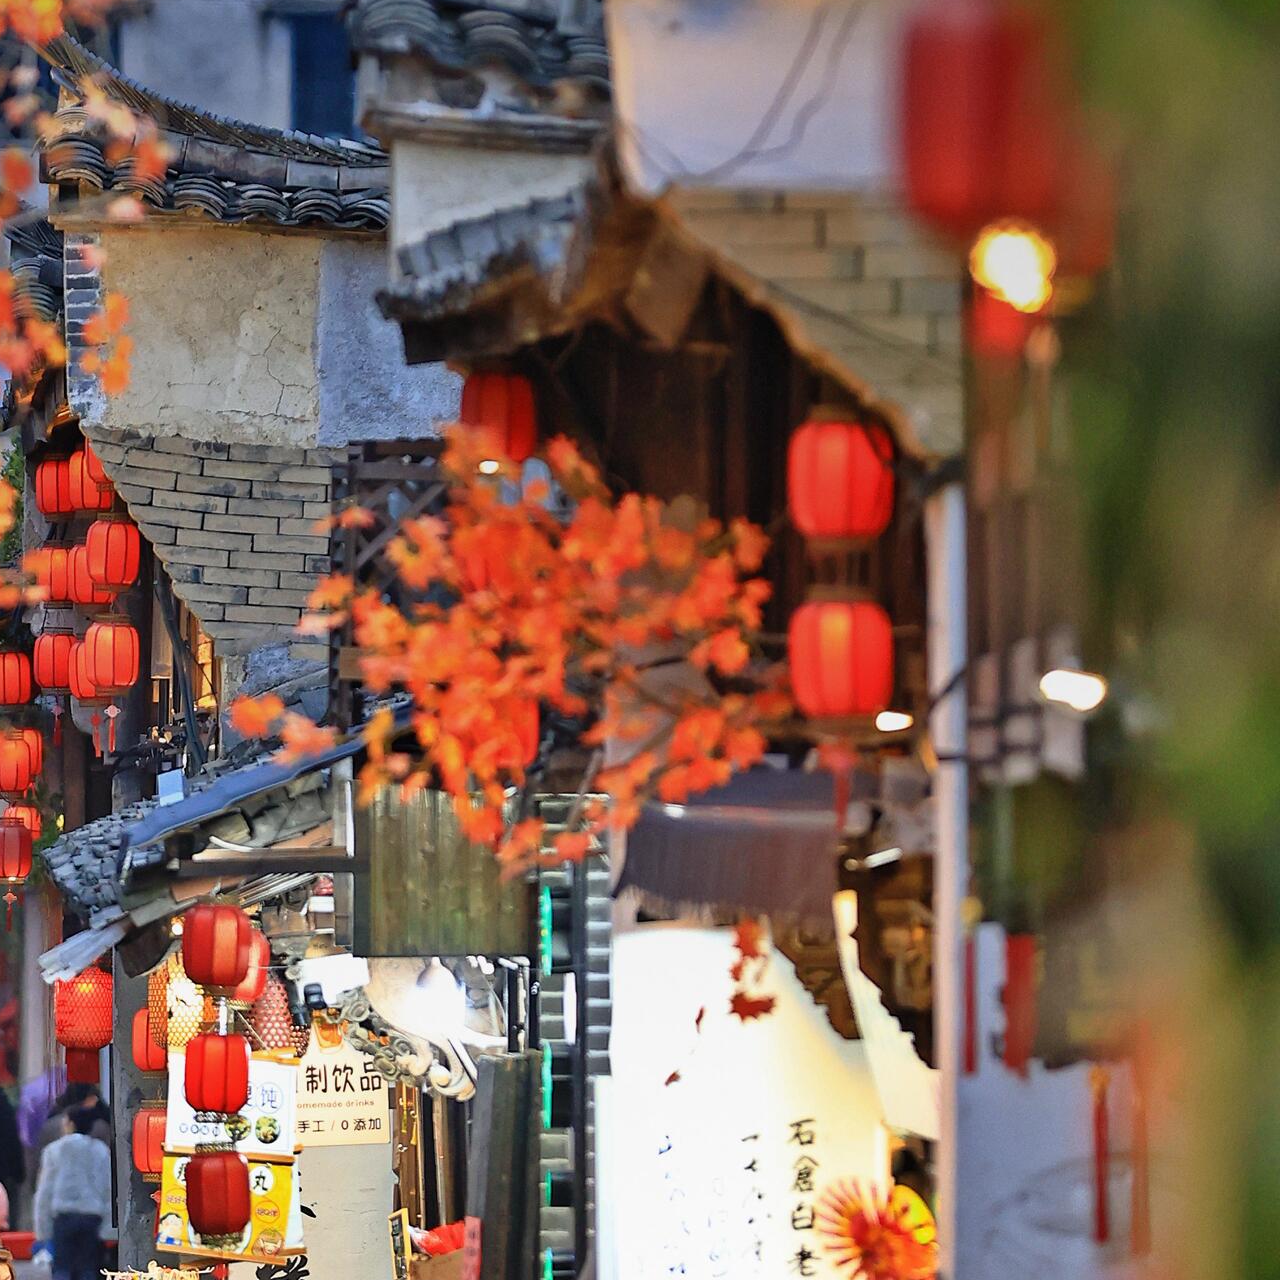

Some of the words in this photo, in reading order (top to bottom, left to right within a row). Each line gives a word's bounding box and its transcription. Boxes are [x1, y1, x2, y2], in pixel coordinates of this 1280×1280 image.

[296, 1061, 382, 1094] 制饮品
[297, 1100, 343, 1109] omemade
[296, 1120, 325, 1133] 手工
